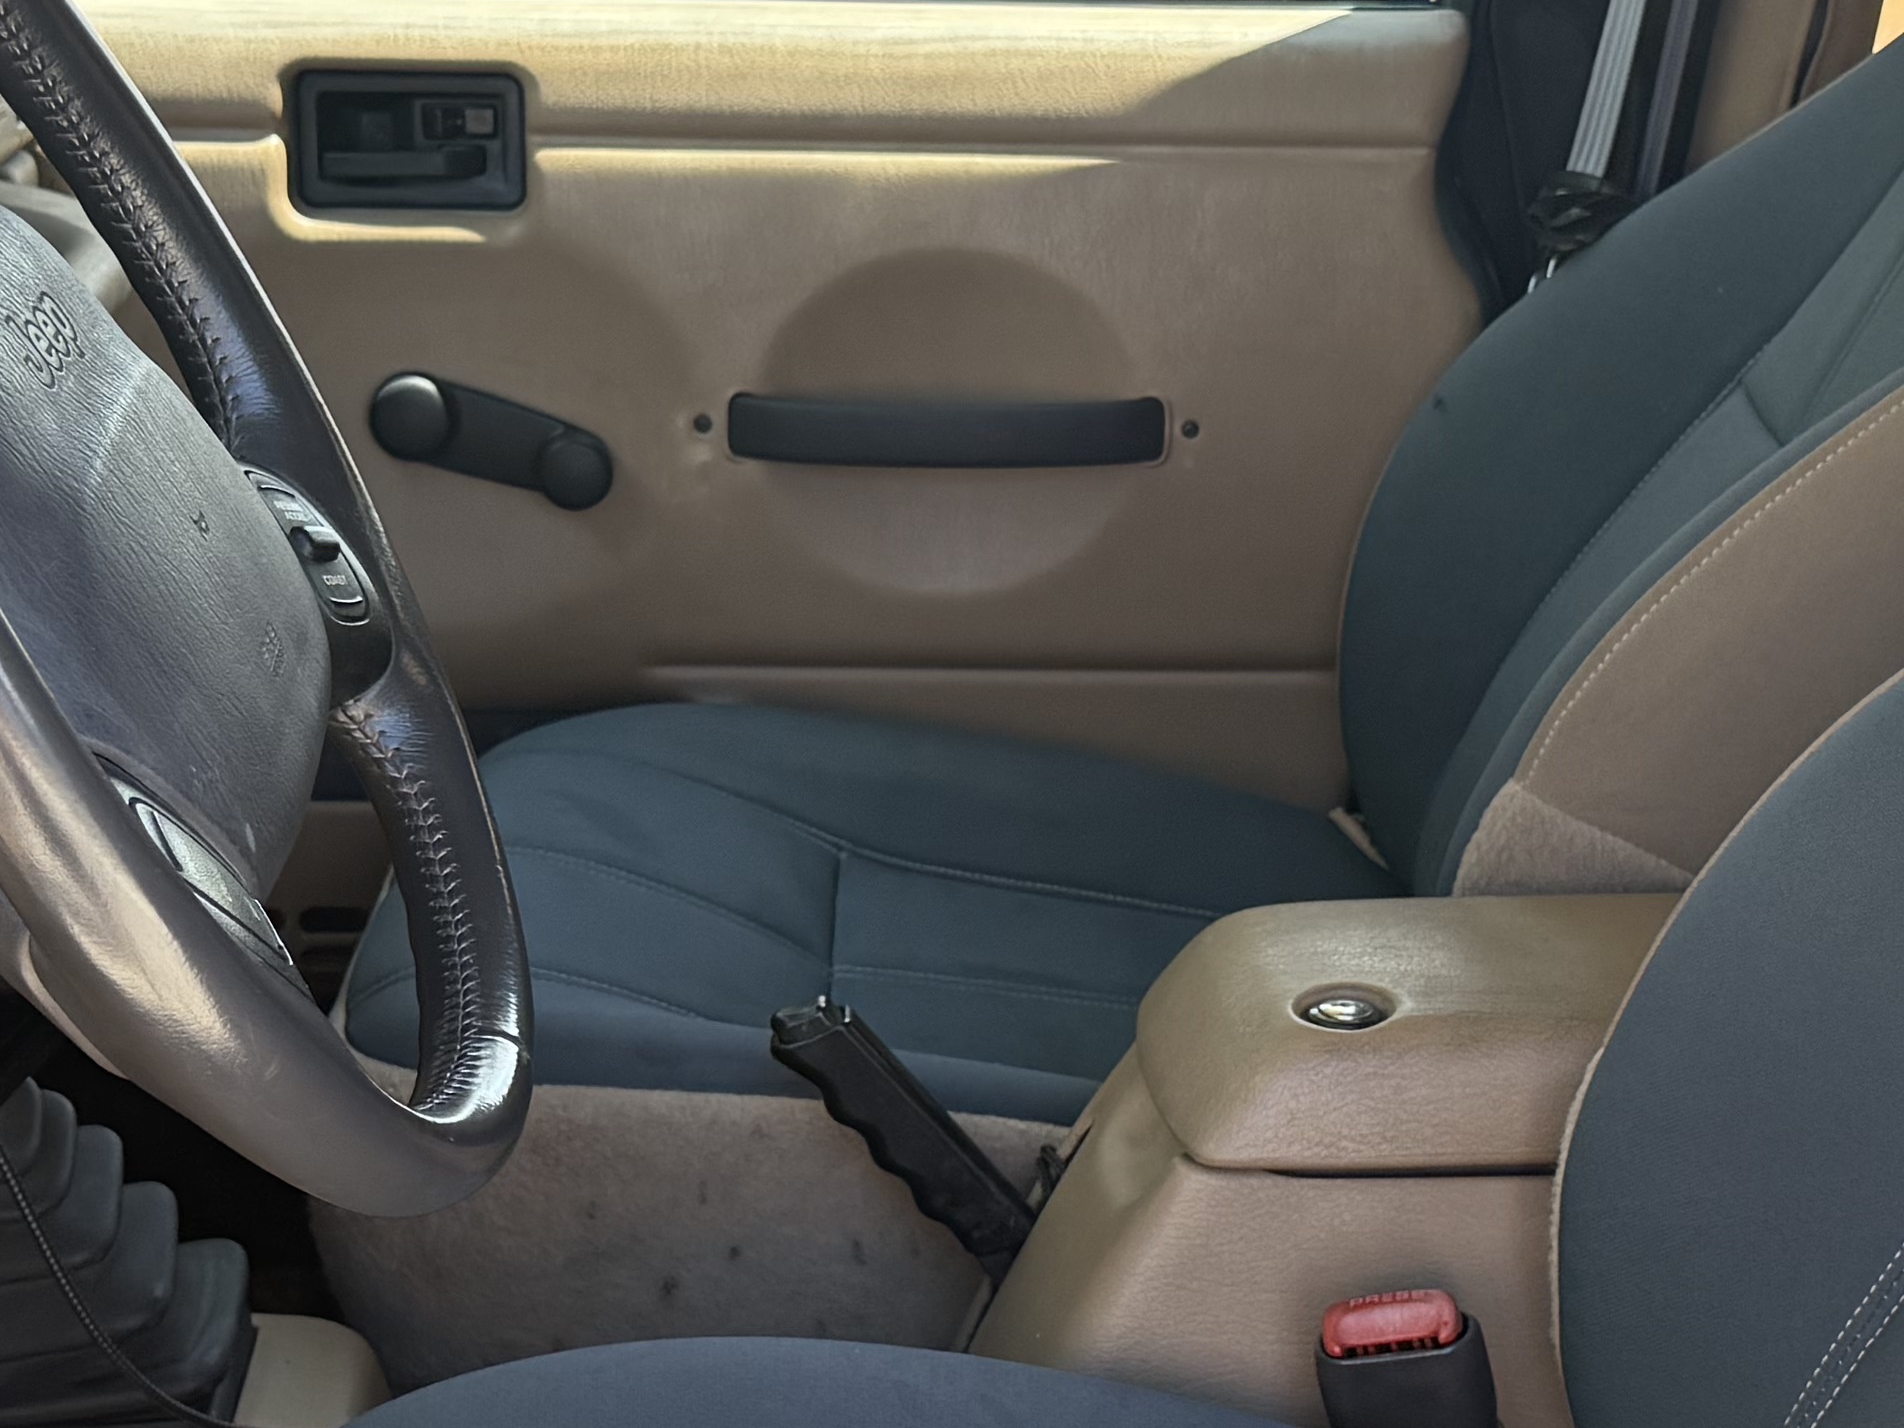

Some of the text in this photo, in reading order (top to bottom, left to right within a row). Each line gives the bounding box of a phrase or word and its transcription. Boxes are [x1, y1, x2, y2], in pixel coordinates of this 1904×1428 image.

[4, 291, 86, 390] Jeep
[322, 575, 348, 586] COAST
[1349, 1289, 1425, 1309] PRESS
